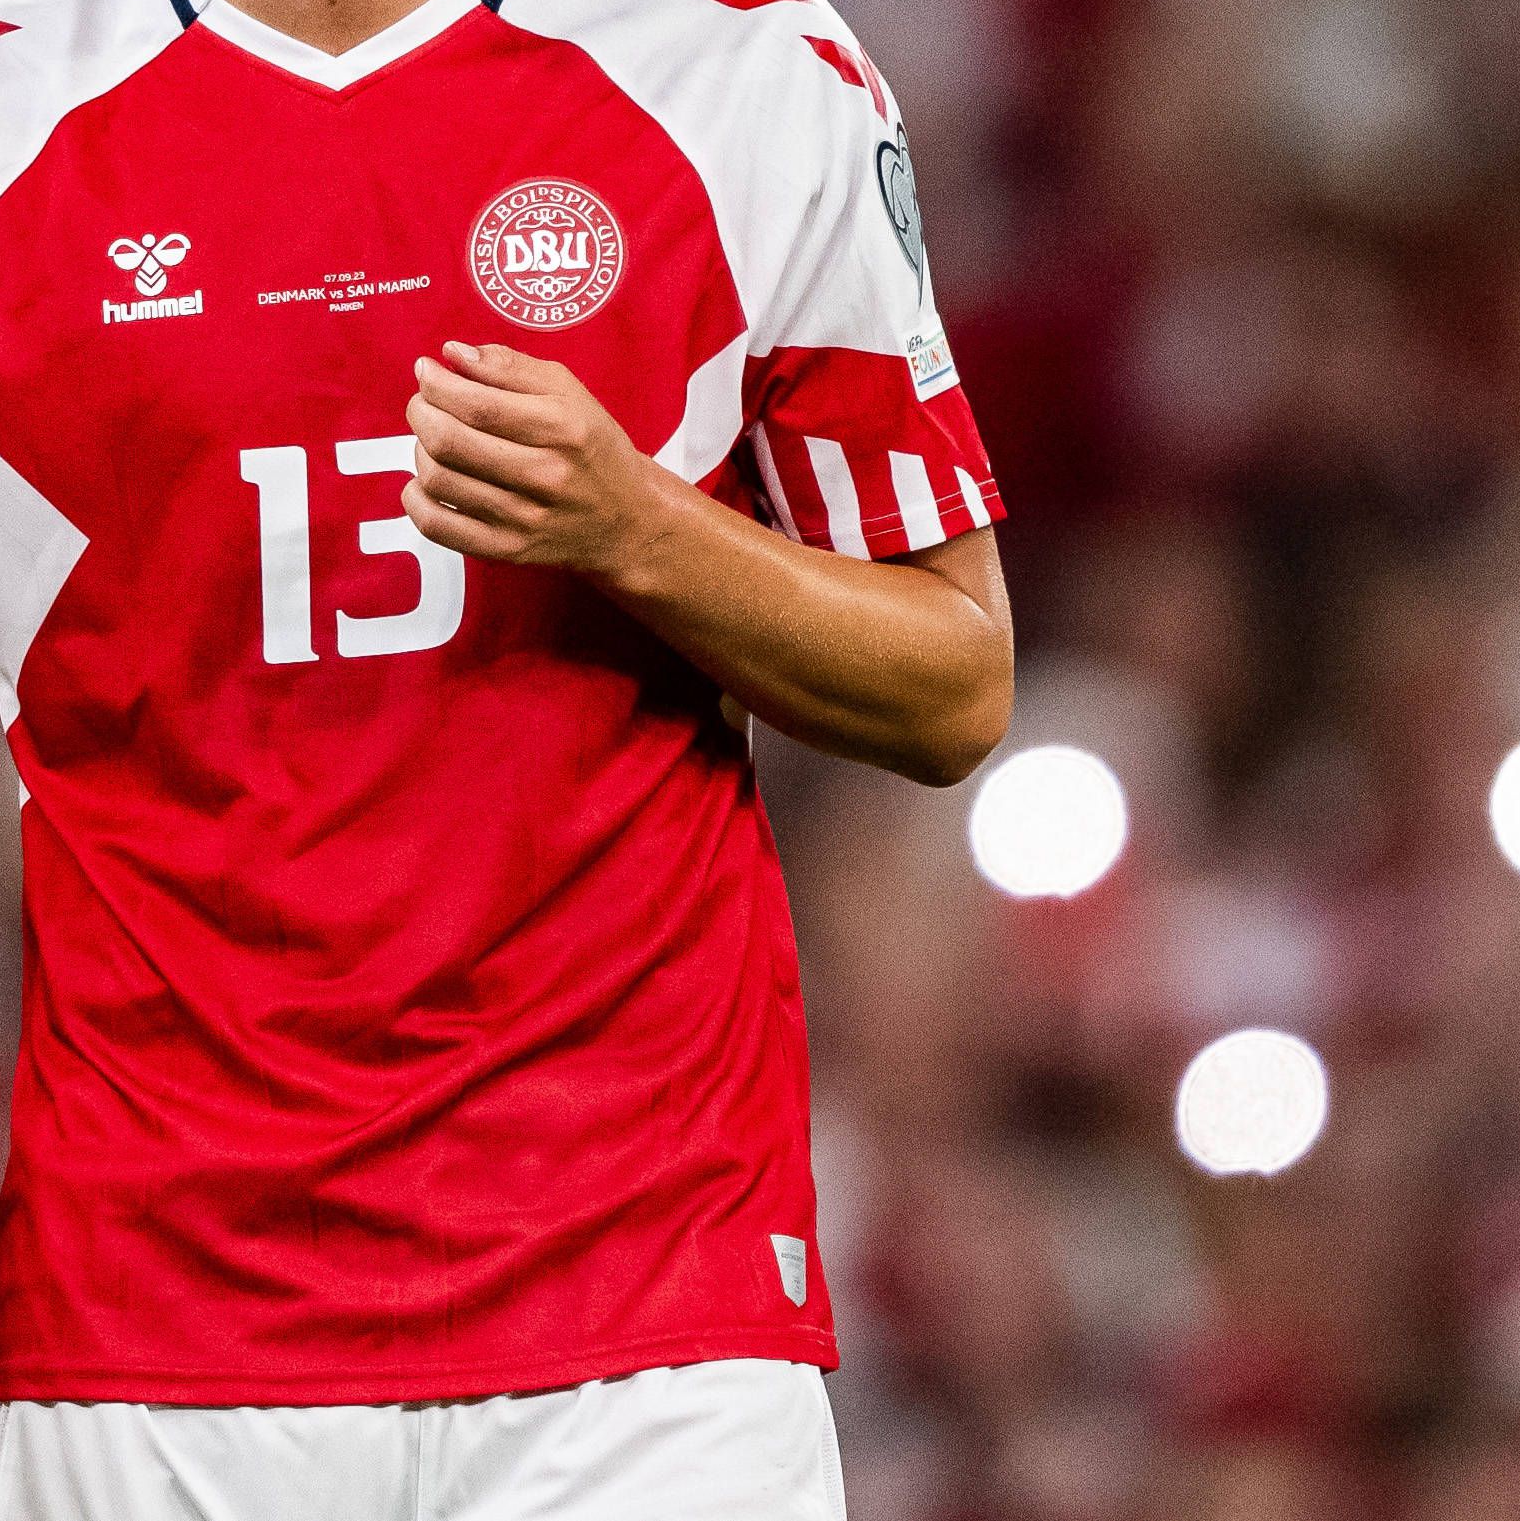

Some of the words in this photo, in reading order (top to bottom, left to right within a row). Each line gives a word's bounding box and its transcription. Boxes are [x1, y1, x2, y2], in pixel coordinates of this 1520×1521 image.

[476, 226, 514, 309] DANSK
[585, 225, 617, 301] UNION
[502, 229, 592, 273] DBU
[257, 287, 327, 306] DENMARK
[329, 290, 344, 300] vs
[346, 284, 375, 298] SAN
[378, 275, 431, 294] MARINO
[323, 271, 366, 283] 07.09.23
[102, 289, 204, 324] hummel
[329, 301, 365, 313] PARKEN
[522, 302, 581, 323] 1889
[239, 434, 466, 664] 13
